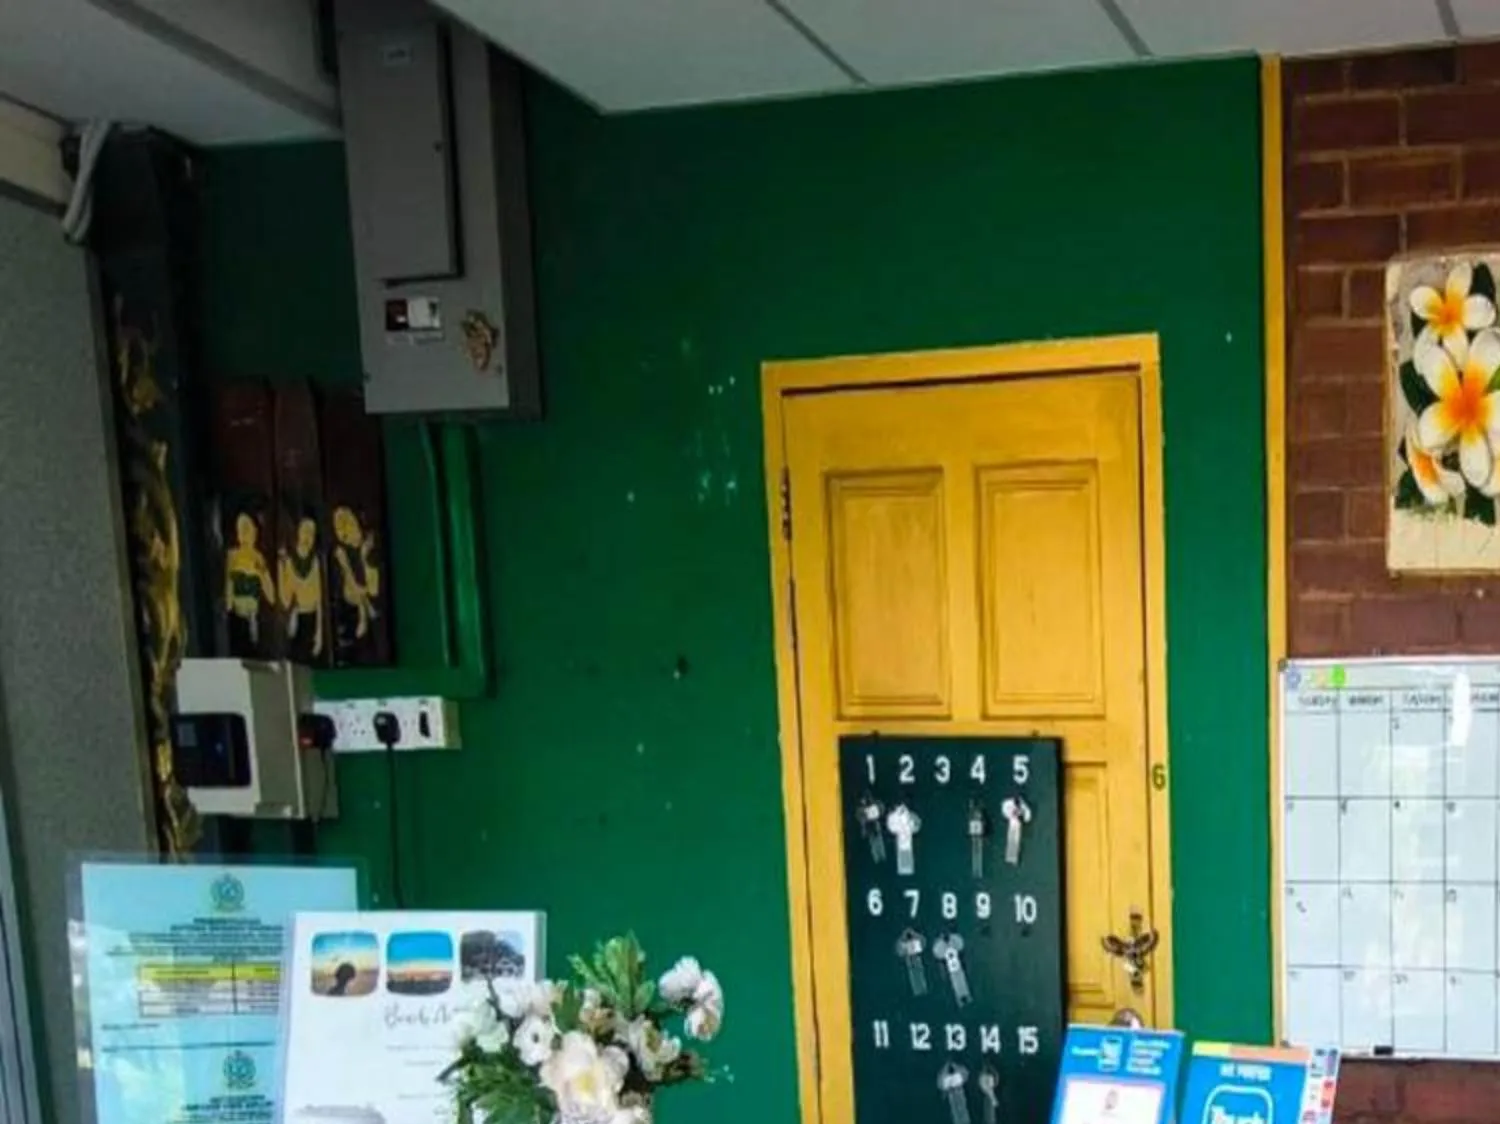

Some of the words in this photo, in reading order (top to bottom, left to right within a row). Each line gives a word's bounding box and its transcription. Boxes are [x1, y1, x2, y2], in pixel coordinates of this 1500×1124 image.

[866, 754, 876, 784] 1
[898, 754, 915, 784] 2
[935, 756, 951, 784] 3
[970, 754, 986, 785] 4
[1012, 755, 1030, 784] 5
[1151, 764, 1166, 791] 6
[867, 888, 883, 915] 6
[904, 889, 920, 918] 7
[941, 892, 957, 919] 8
[976, 892, 991, 919] 9
[1014, 895, 1037, 923] 10
[873, 1020, 890, 1048] 11
[909, 1022, 931, 1051] 12
[945, 1023, 966, 1051] 13
[980, 1025, 1001, 1054] 14
[1018, 1026, 1040, 1055] 15
